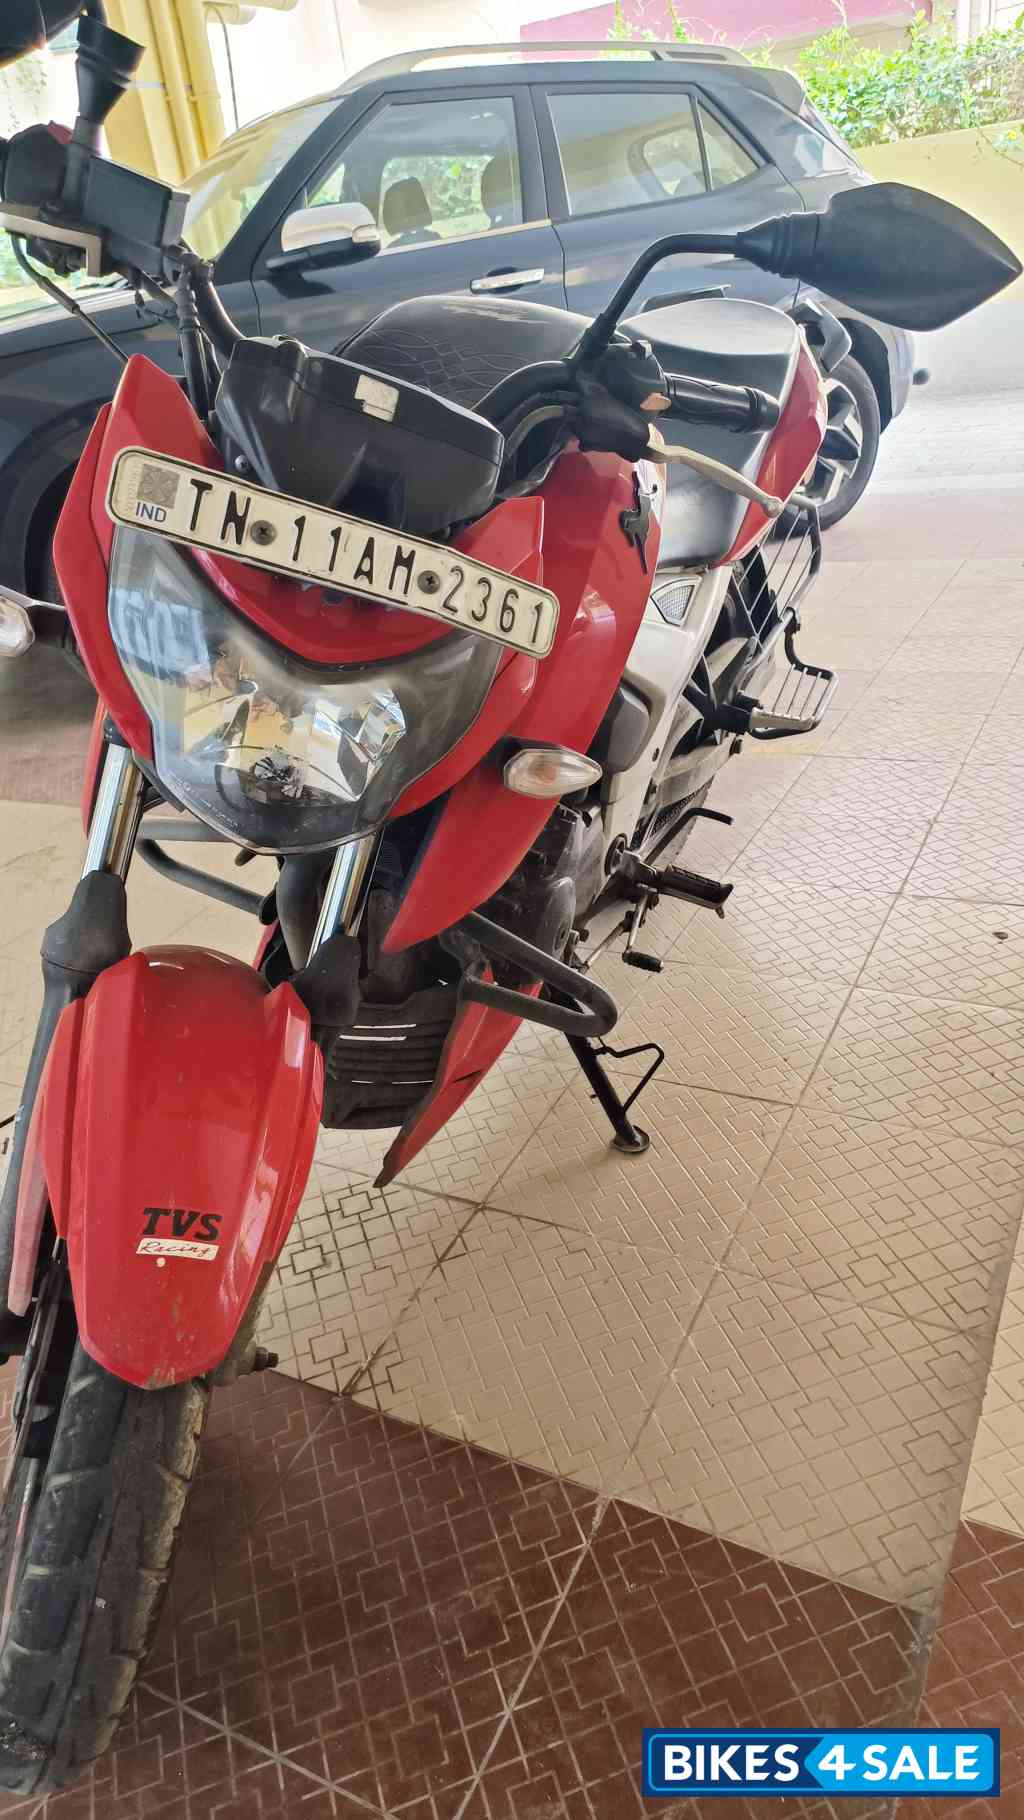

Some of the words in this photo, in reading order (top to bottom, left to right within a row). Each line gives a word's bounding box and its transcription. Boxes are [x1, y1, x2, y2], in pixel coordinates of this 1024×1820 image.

[136, 502, 167, 523] IND
[189, 478, 251, 545] TN
[294, 515, 416, 594] 11AM
[442, 565, 544, 643] 2361
[142, 1207, 223, 1241] TVS
[140, 1241, 210, 1258] Racing
